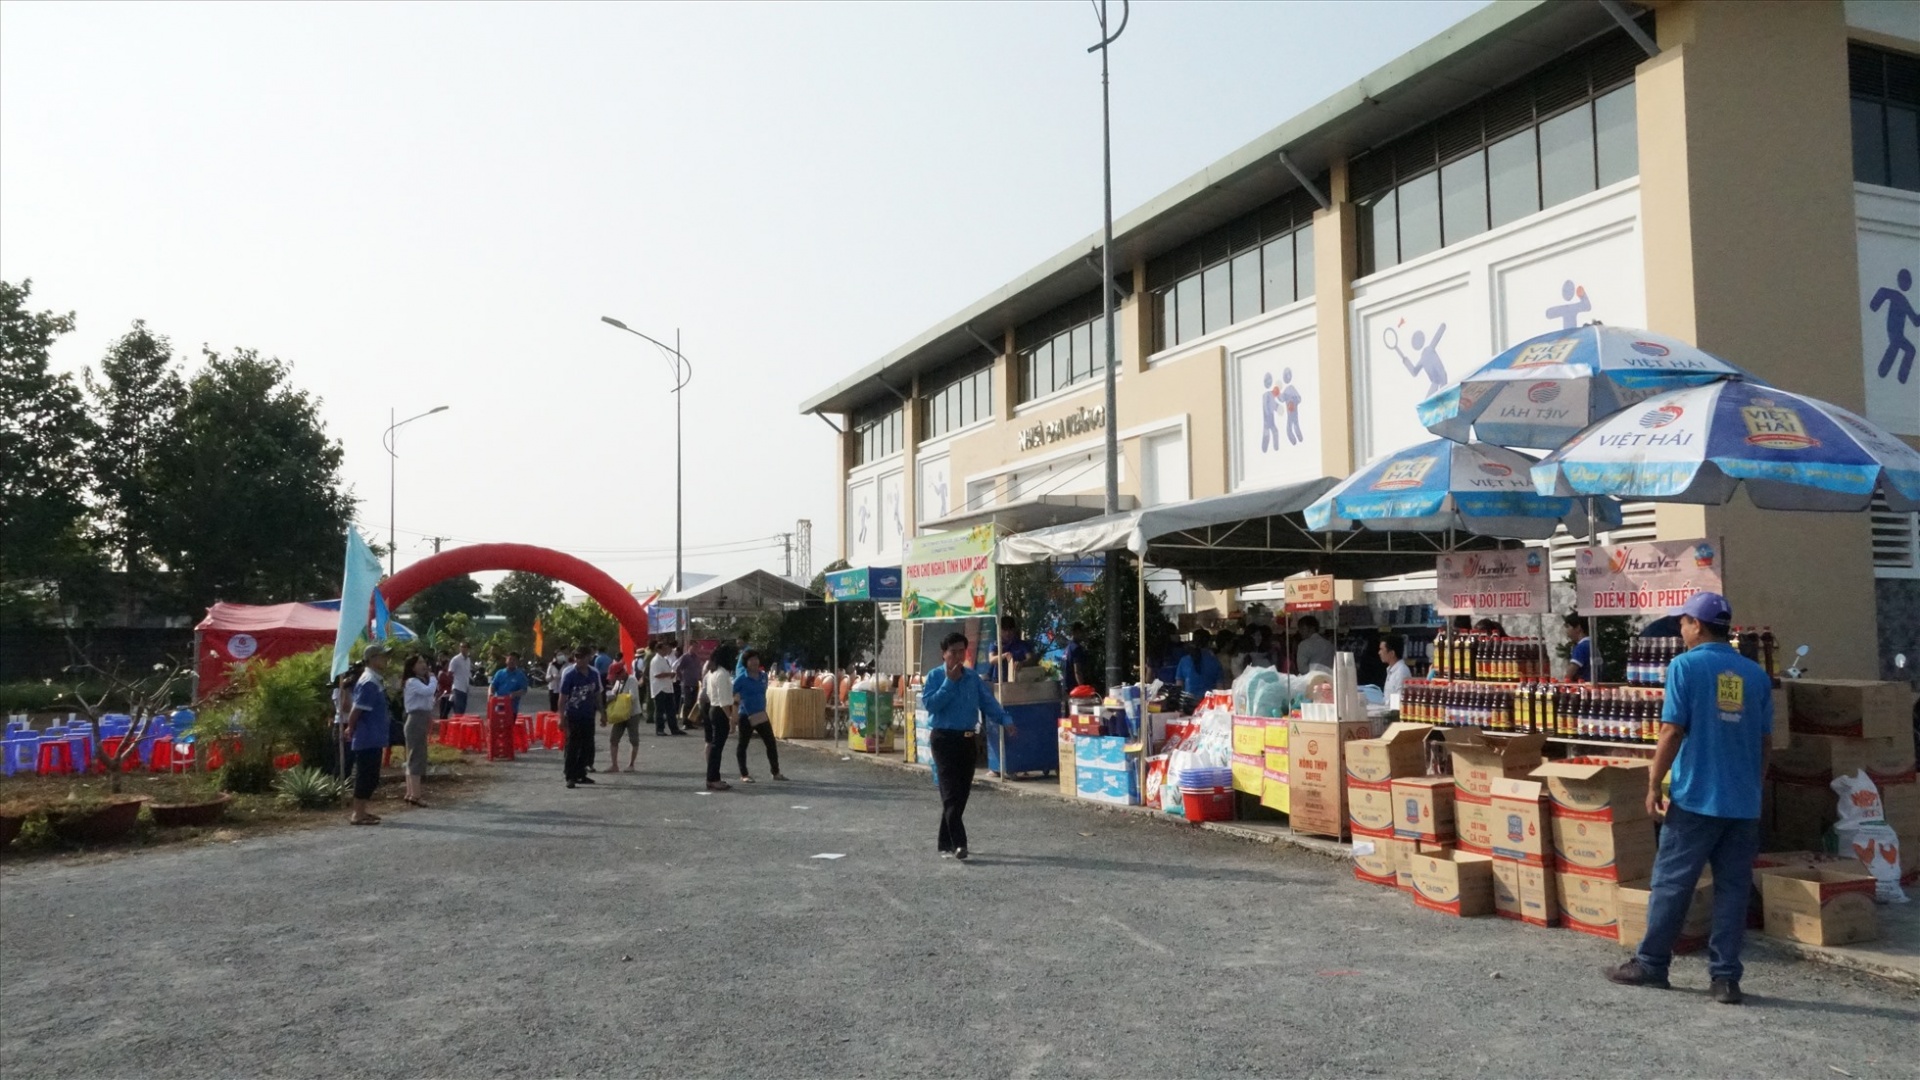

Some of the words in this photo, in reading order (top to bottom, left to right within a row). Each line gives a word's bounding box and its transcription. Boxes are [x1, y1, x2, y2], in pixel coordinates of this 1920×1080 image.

[1599, 431, 1647, 447] VIỆT
[1646, 428, 1693, 446] HẢI
[1500, 586, 1531, 607] PHIẾU
[1594, 583, 1626, 609] ĐIỂM
[1629, 582, 1653, 608] ĐỔI
